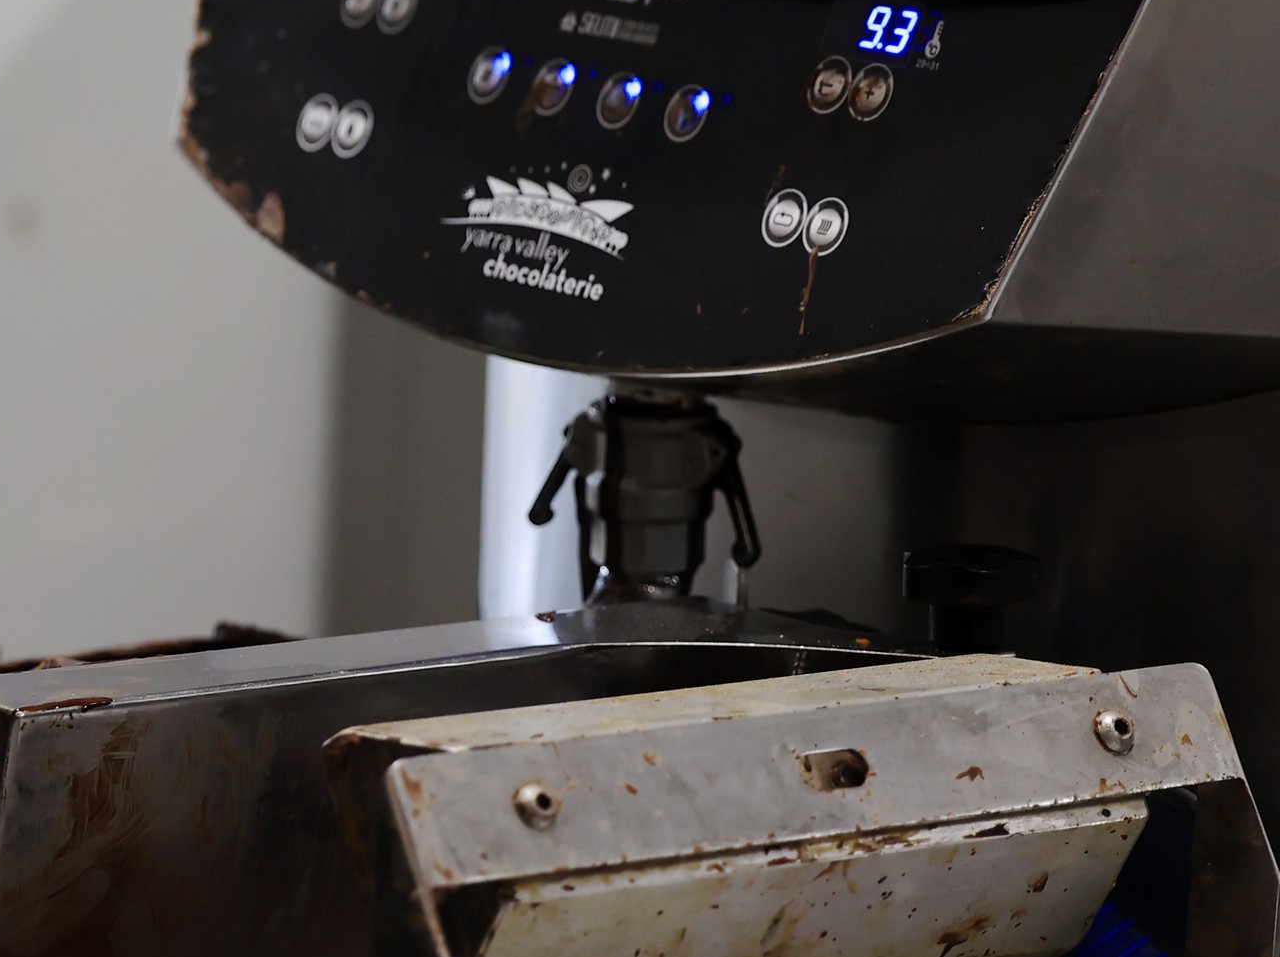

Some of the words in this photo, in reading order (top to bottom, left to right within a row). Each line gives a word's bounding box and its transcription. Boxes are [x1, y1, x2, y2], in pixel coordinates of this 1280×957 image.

[858, 5, 919, 54] 9.3
[460, 226, 514, 254] yarra
[515, 230, 570, 273] valley
[483, 252, 604, 301] chocolaterie
